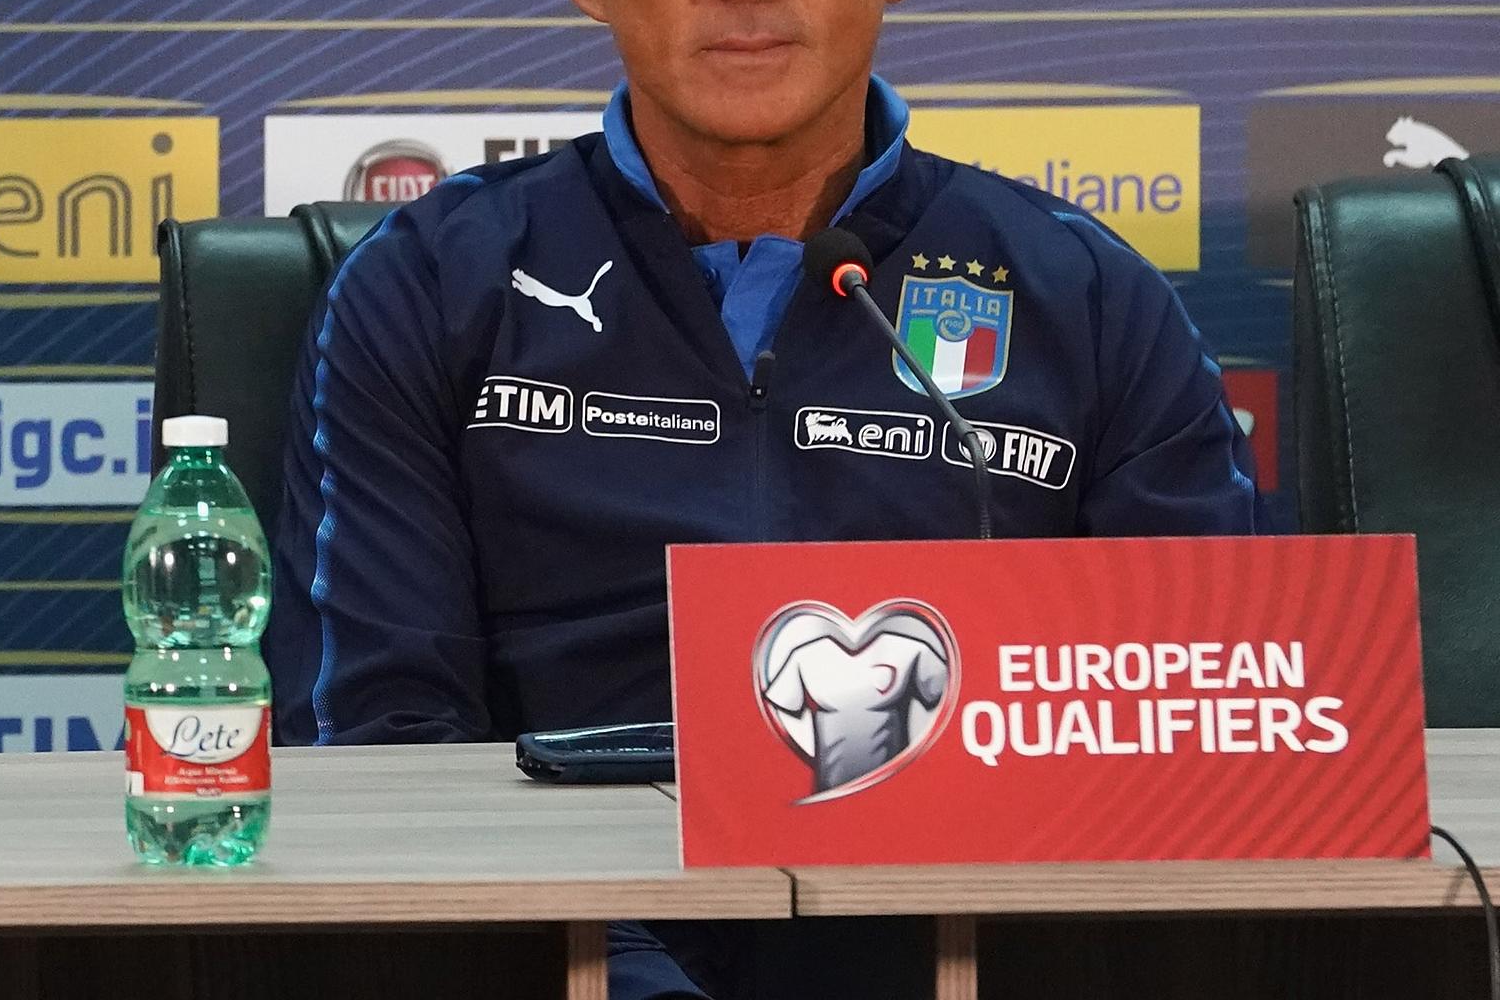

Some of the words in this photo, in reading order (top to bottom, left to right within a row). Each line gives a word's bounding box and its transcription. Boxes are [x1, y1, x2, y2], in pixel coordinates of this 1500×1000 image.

[912, 287, 1000, 316] ITALIA
[494, 384, 565, 426] TIM
[858, 419, 925, 454] eni
[1002, 431, 1061, 480] FIAT
[999, 641, 1305, 692] EUROPEAN
[161, 715, 240, 757] Lete
[961, 696, 1349, 767] QUALIFIERS
